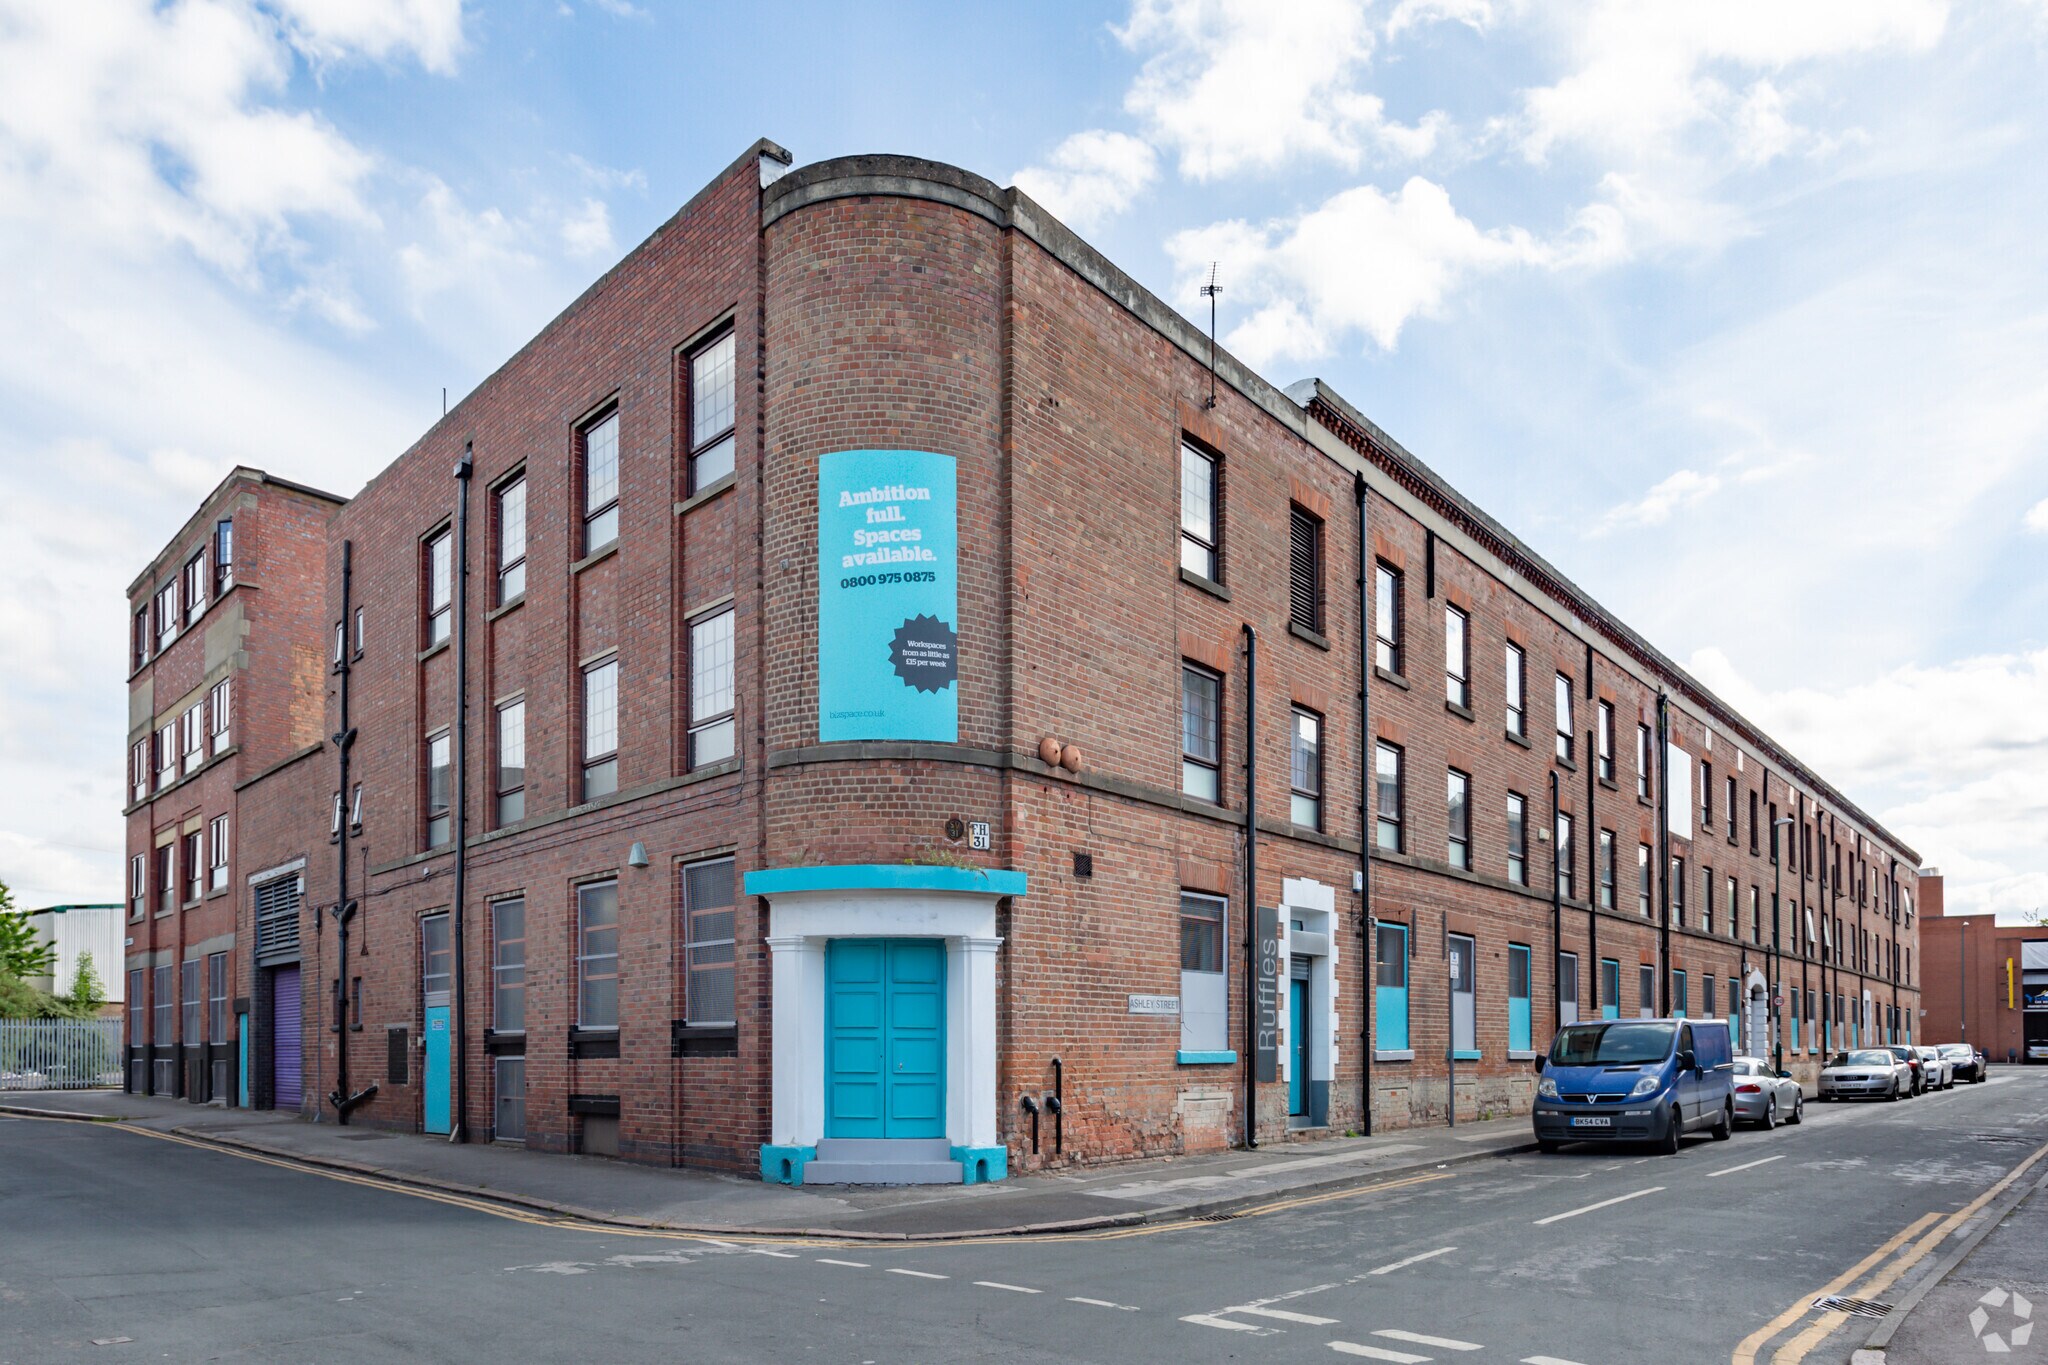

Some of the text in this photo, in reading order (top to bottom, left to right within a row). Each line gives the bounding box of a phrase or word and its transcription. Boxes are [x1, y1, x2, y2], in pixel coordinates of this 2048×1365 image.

[839, 485, 931, 507] Ambition
[865, 506, 906, 524] full.
[853, 528, 922, 547] Spaces
[842, 546, 937, 568] available.
[840, 571, 936, 589] 0800 975 0875
[907, 640, 946, 649] Workspaces
[927, 650, 942, 658] little
[829, 710, 885, 719] bizspace.co.uk
[974, 836, 985, 847] 31
[1258, 939, 1276, 1051] Ruffles
[1129, 999, 1179, 1010] ASHLEY STREET
